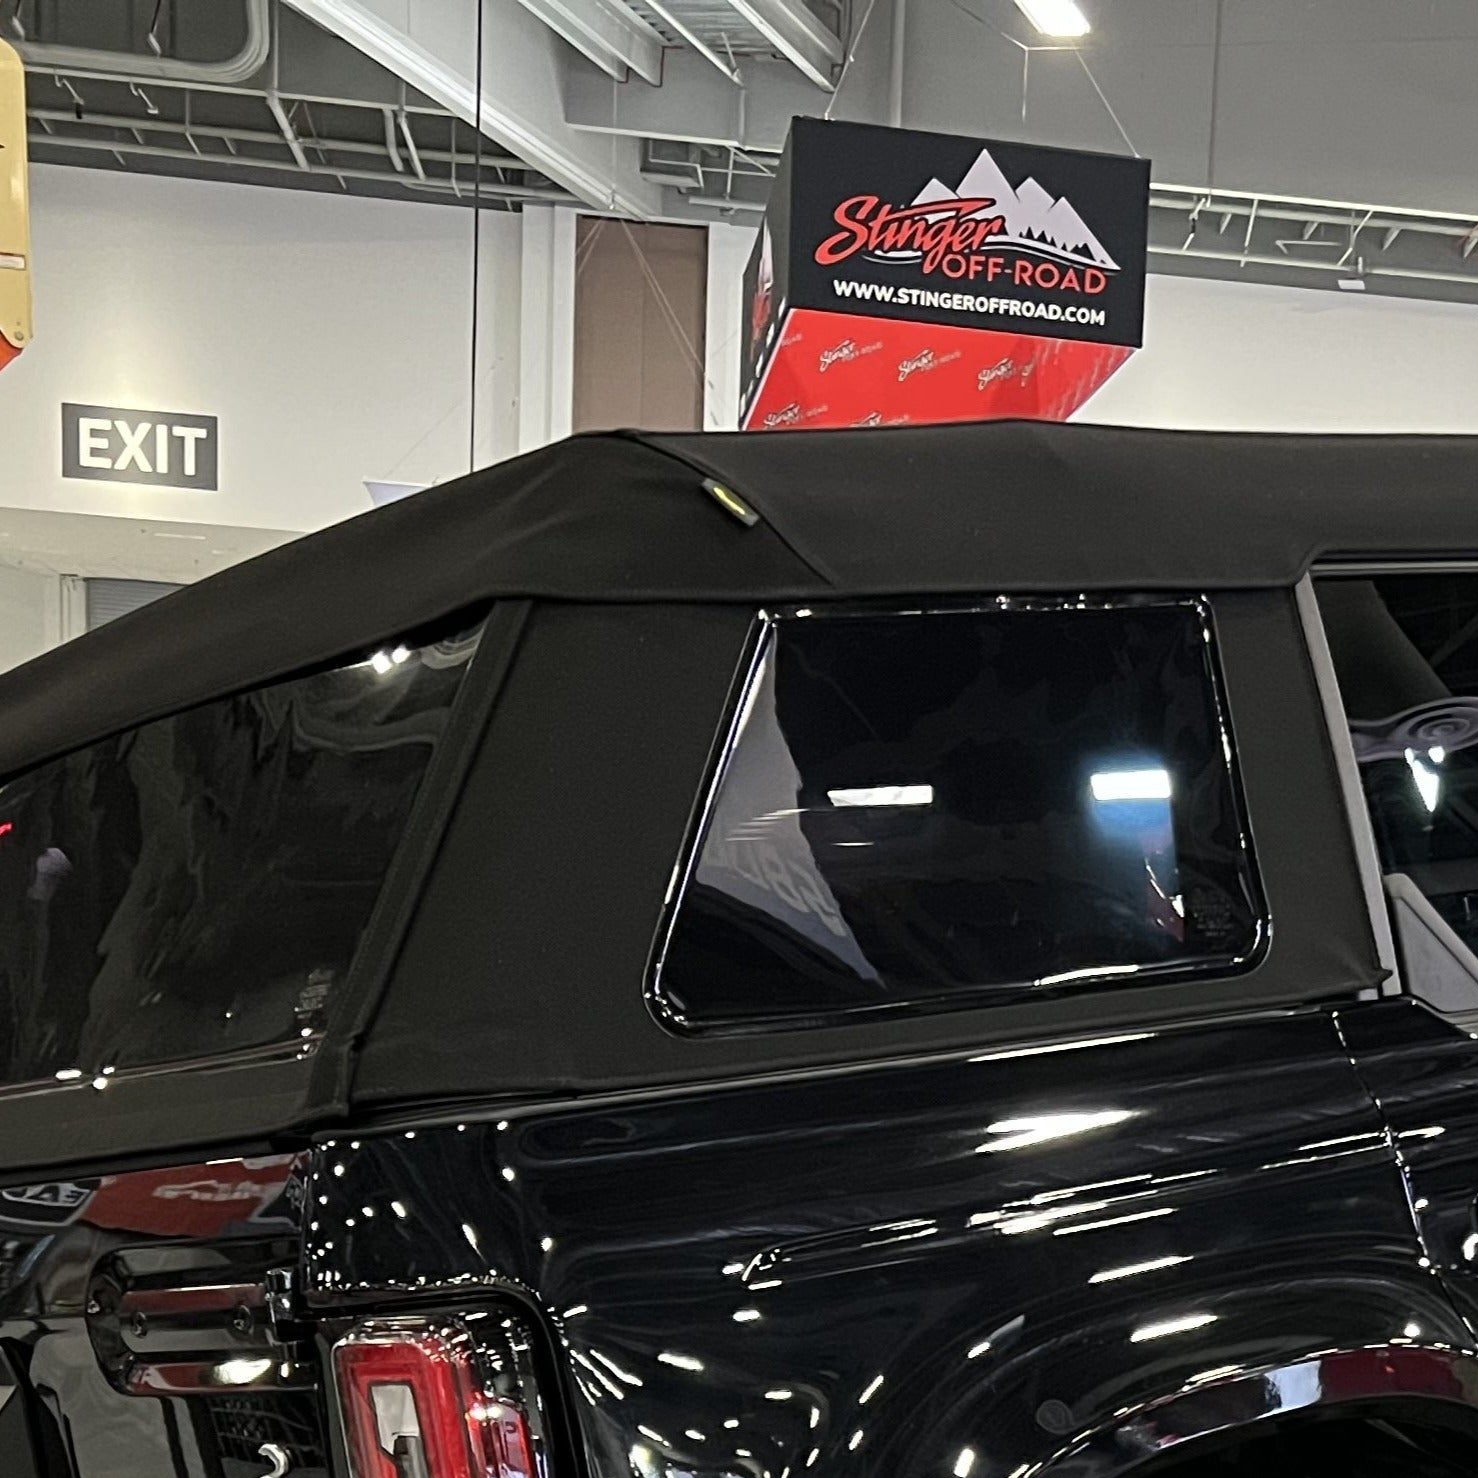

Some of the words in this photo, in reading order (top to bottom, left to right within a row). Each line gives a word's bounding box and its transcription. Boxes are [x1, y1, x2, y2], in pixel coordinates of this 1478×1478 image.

[815, 196, 1005, 274] Stinger
[942, 252, 1107, 294] OFF-ROAD
[833, 279, 1105, 326] WWW.STINGEROFFROAD.COM
[78, 417, 207, 476] EXIT
